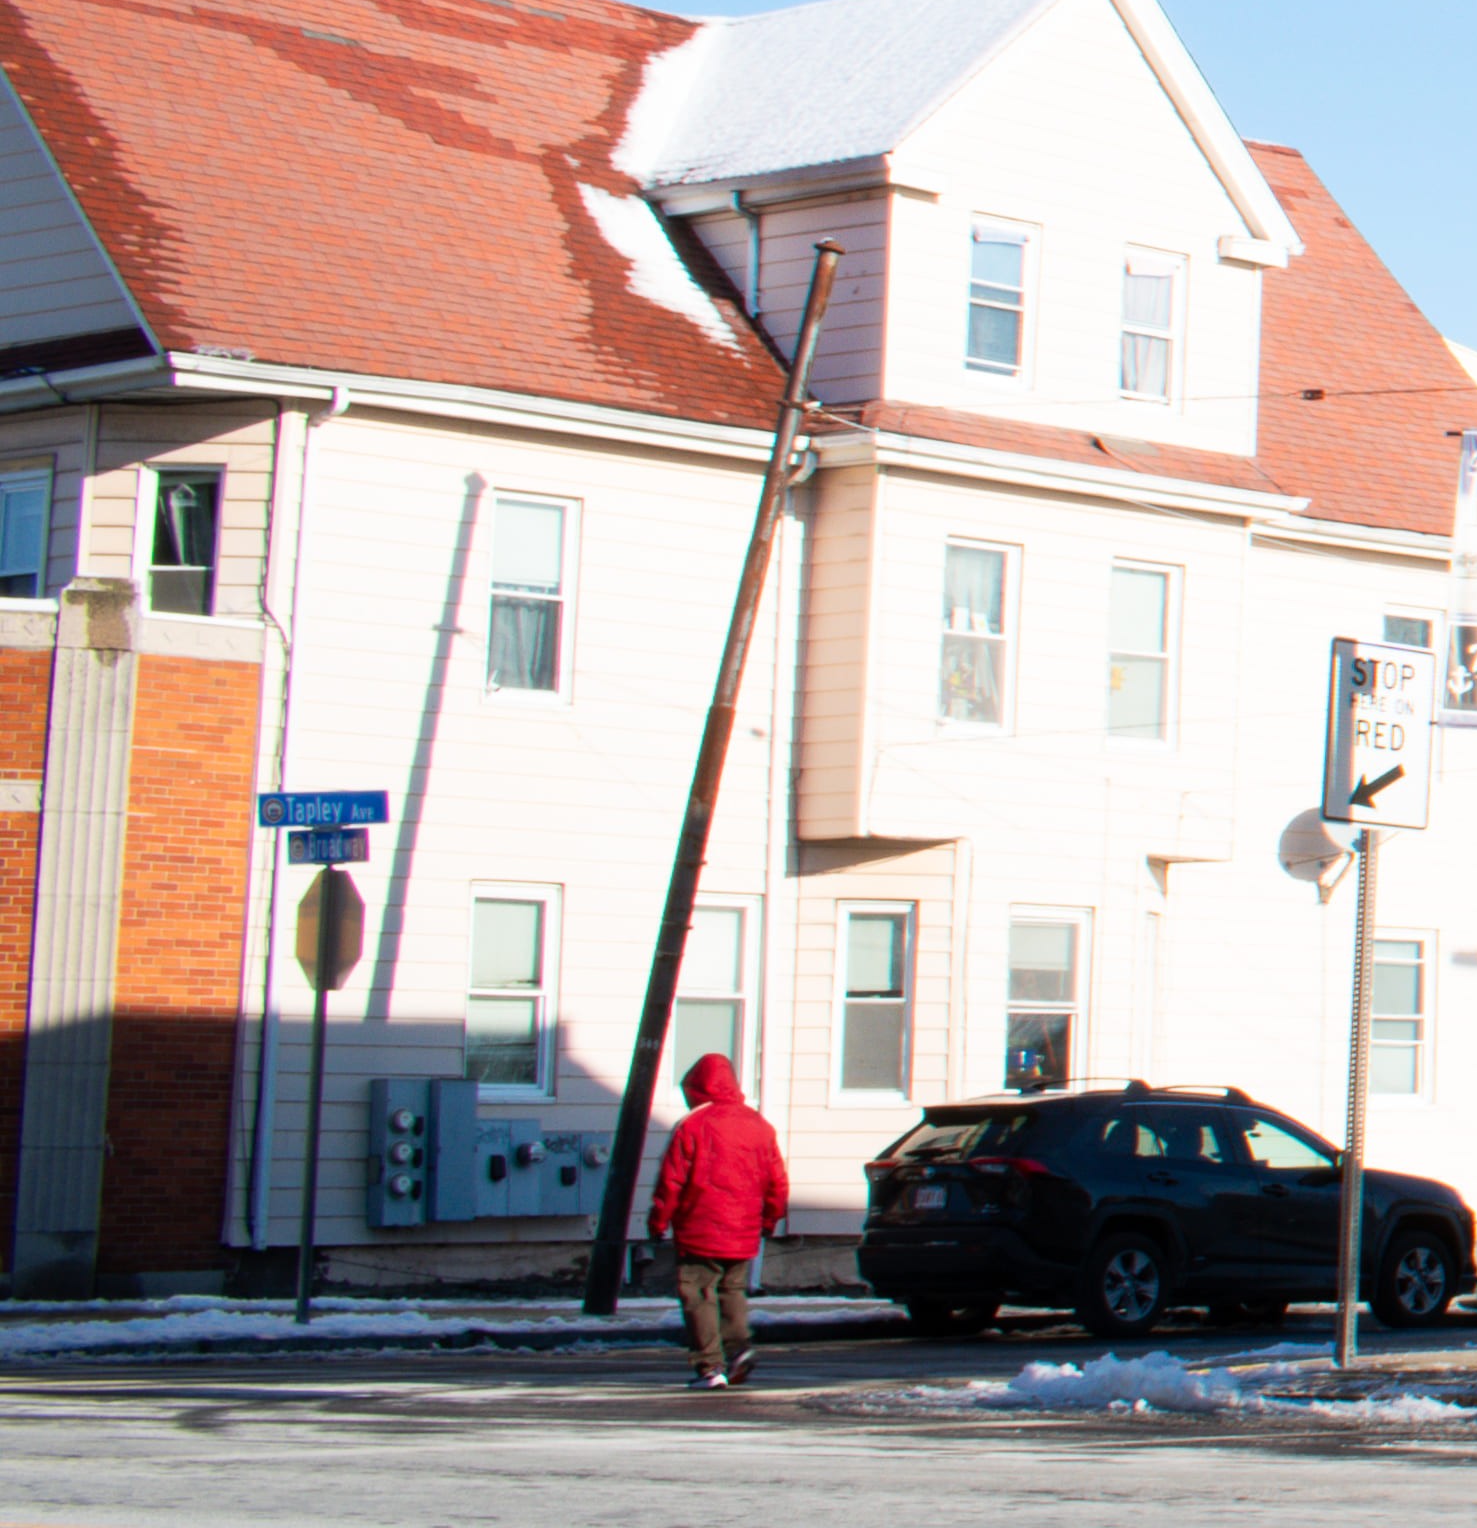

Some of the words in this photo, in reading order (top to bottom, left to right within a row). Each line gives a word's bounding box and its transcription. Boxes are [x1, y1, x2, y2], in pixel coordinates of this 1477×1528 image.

[1351, 657, 1415, 691] STOP
[1355, 719, 1406, 752] RED
[286, 796, 343, 824] Tapley
[308, 833, 365, 860] Broadway
